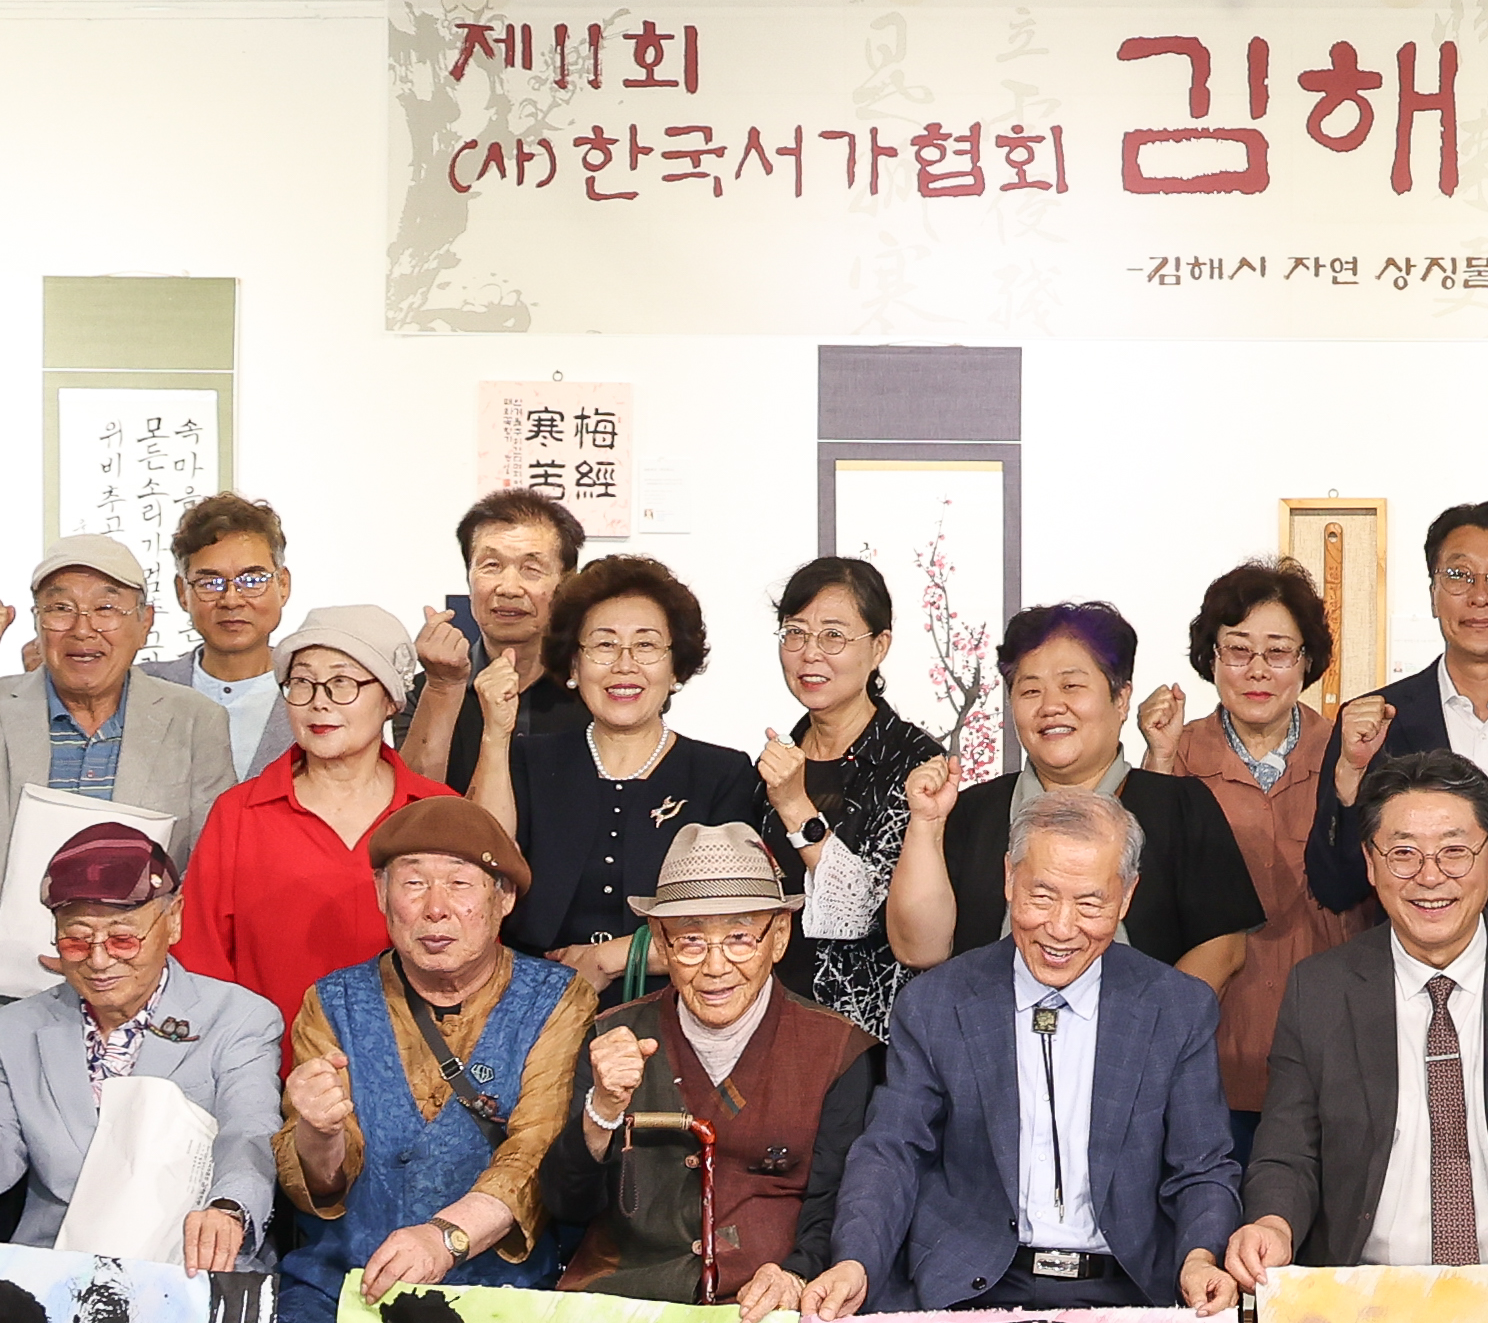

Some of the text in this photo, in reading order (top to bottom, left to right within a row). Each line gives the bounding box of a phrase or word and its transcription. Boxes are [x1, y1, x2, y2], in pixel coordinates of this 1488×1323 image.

[450, 21, 698, 94] 제11회
[448, 123, 1067, 201] (사)한국서가협회
[1284, 256, 1359, 285] 자연
